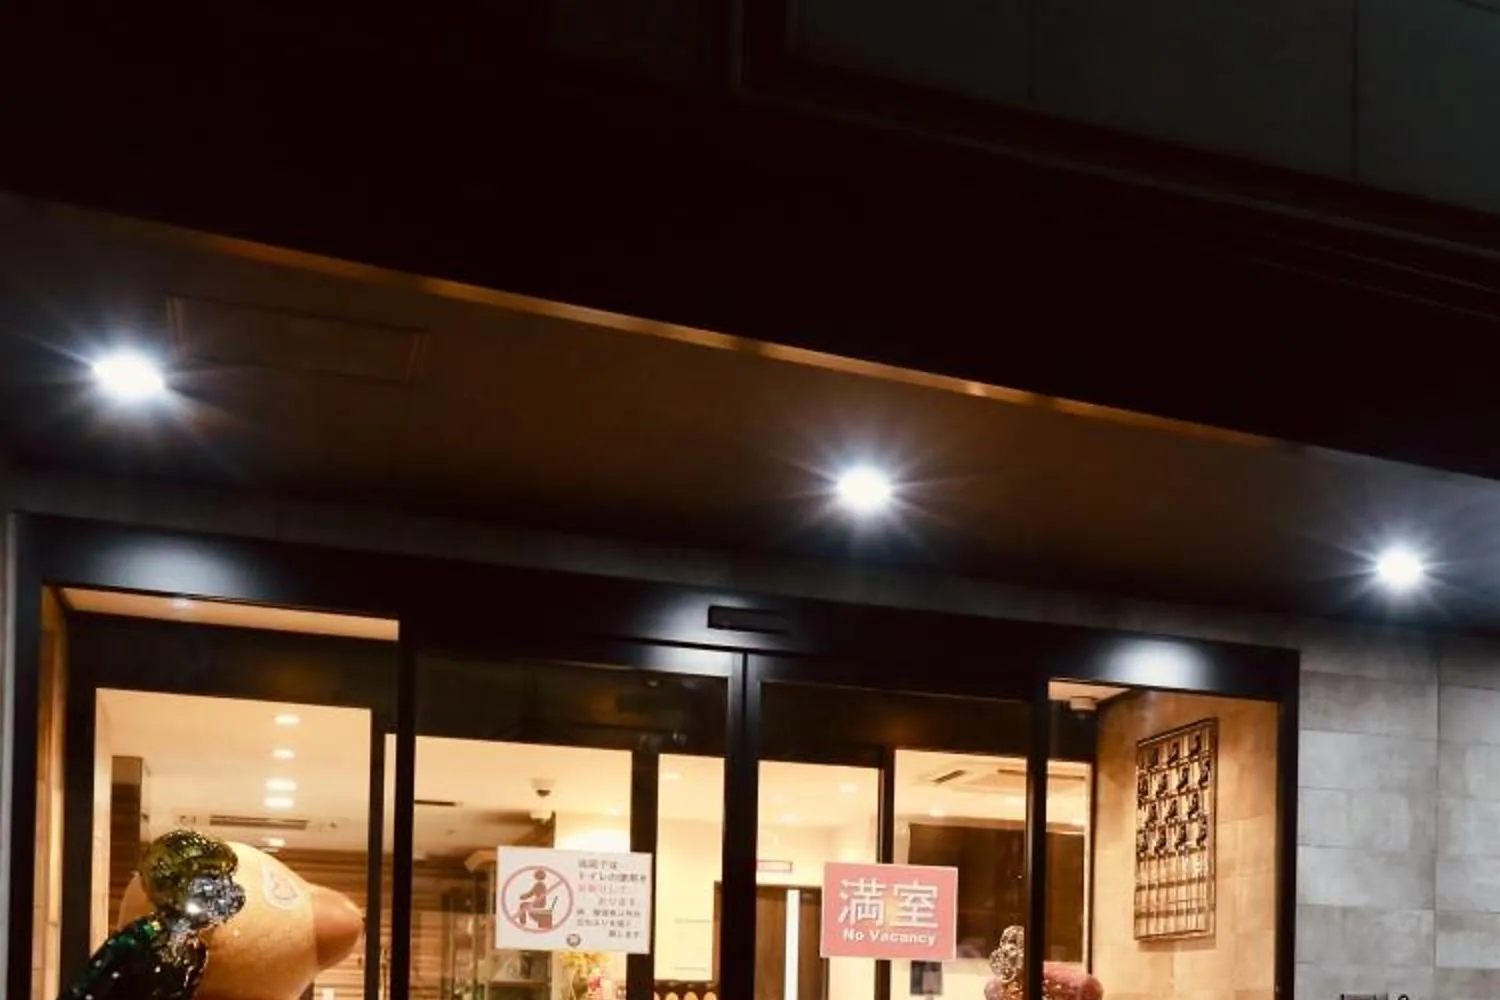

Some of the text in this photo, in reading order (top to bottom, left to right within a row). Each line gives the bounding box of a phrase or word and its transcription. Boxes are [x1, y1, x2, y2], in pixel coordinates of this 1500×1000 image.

[838, 878, 939, 928] 満室
[843, 928, 936, 946] No Vacancy
